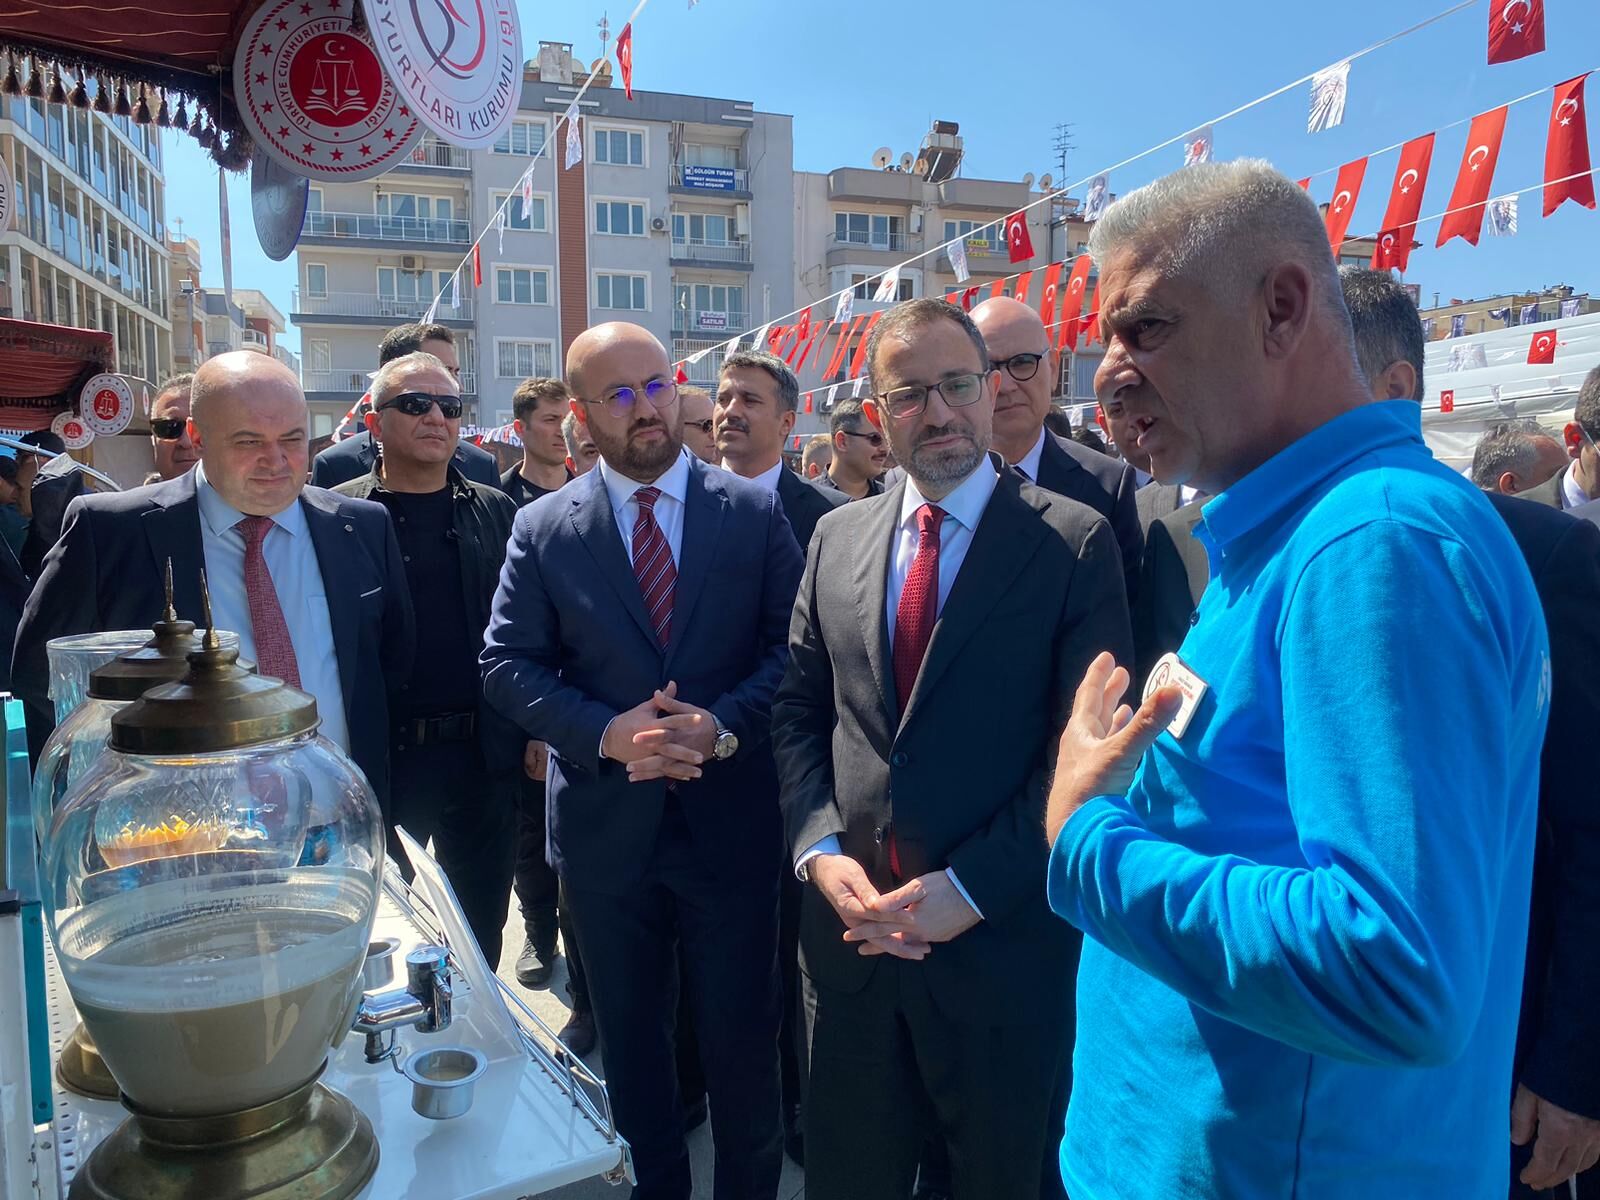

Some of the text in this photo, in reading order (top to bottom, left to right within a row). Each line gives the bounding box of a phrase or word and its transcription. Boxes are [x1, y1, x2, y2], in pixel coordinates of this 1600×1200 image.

[278, 21, 342, 77] CUMHURİYETİ
[381, 11, 513, 132] YURTLARI KURUMU
[278, 83, 312, 130] TÜRKİYE
